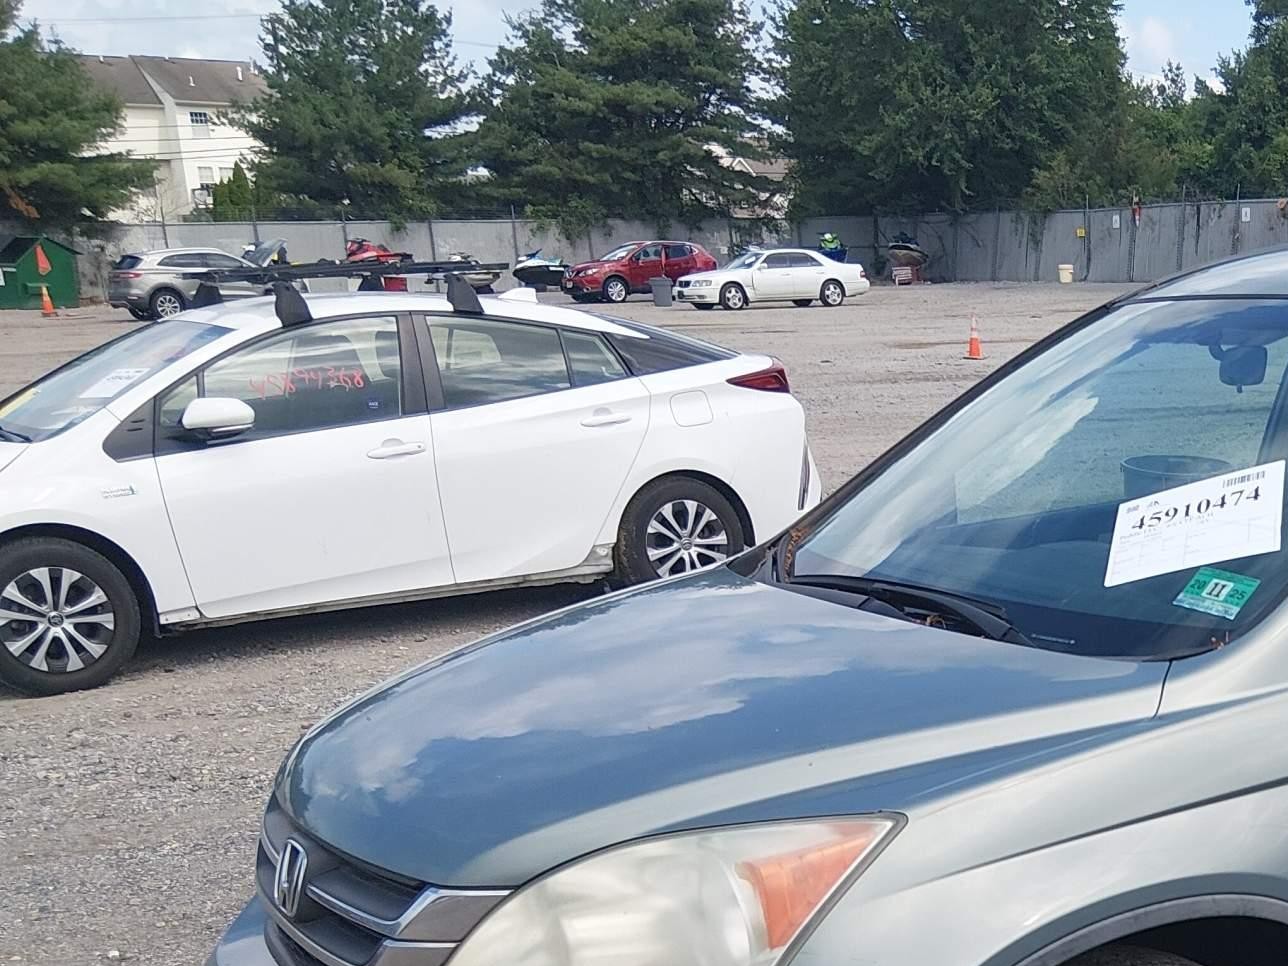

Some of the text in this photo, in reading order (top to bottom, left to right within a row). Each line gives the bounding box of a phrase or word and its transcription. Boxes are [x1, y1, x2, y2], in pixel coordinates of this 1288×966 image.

[1131, 485, 1261, 530] 45910474
[1206, 582, 1228, 598] 11
[1229, 589, 1247, 600] 25
